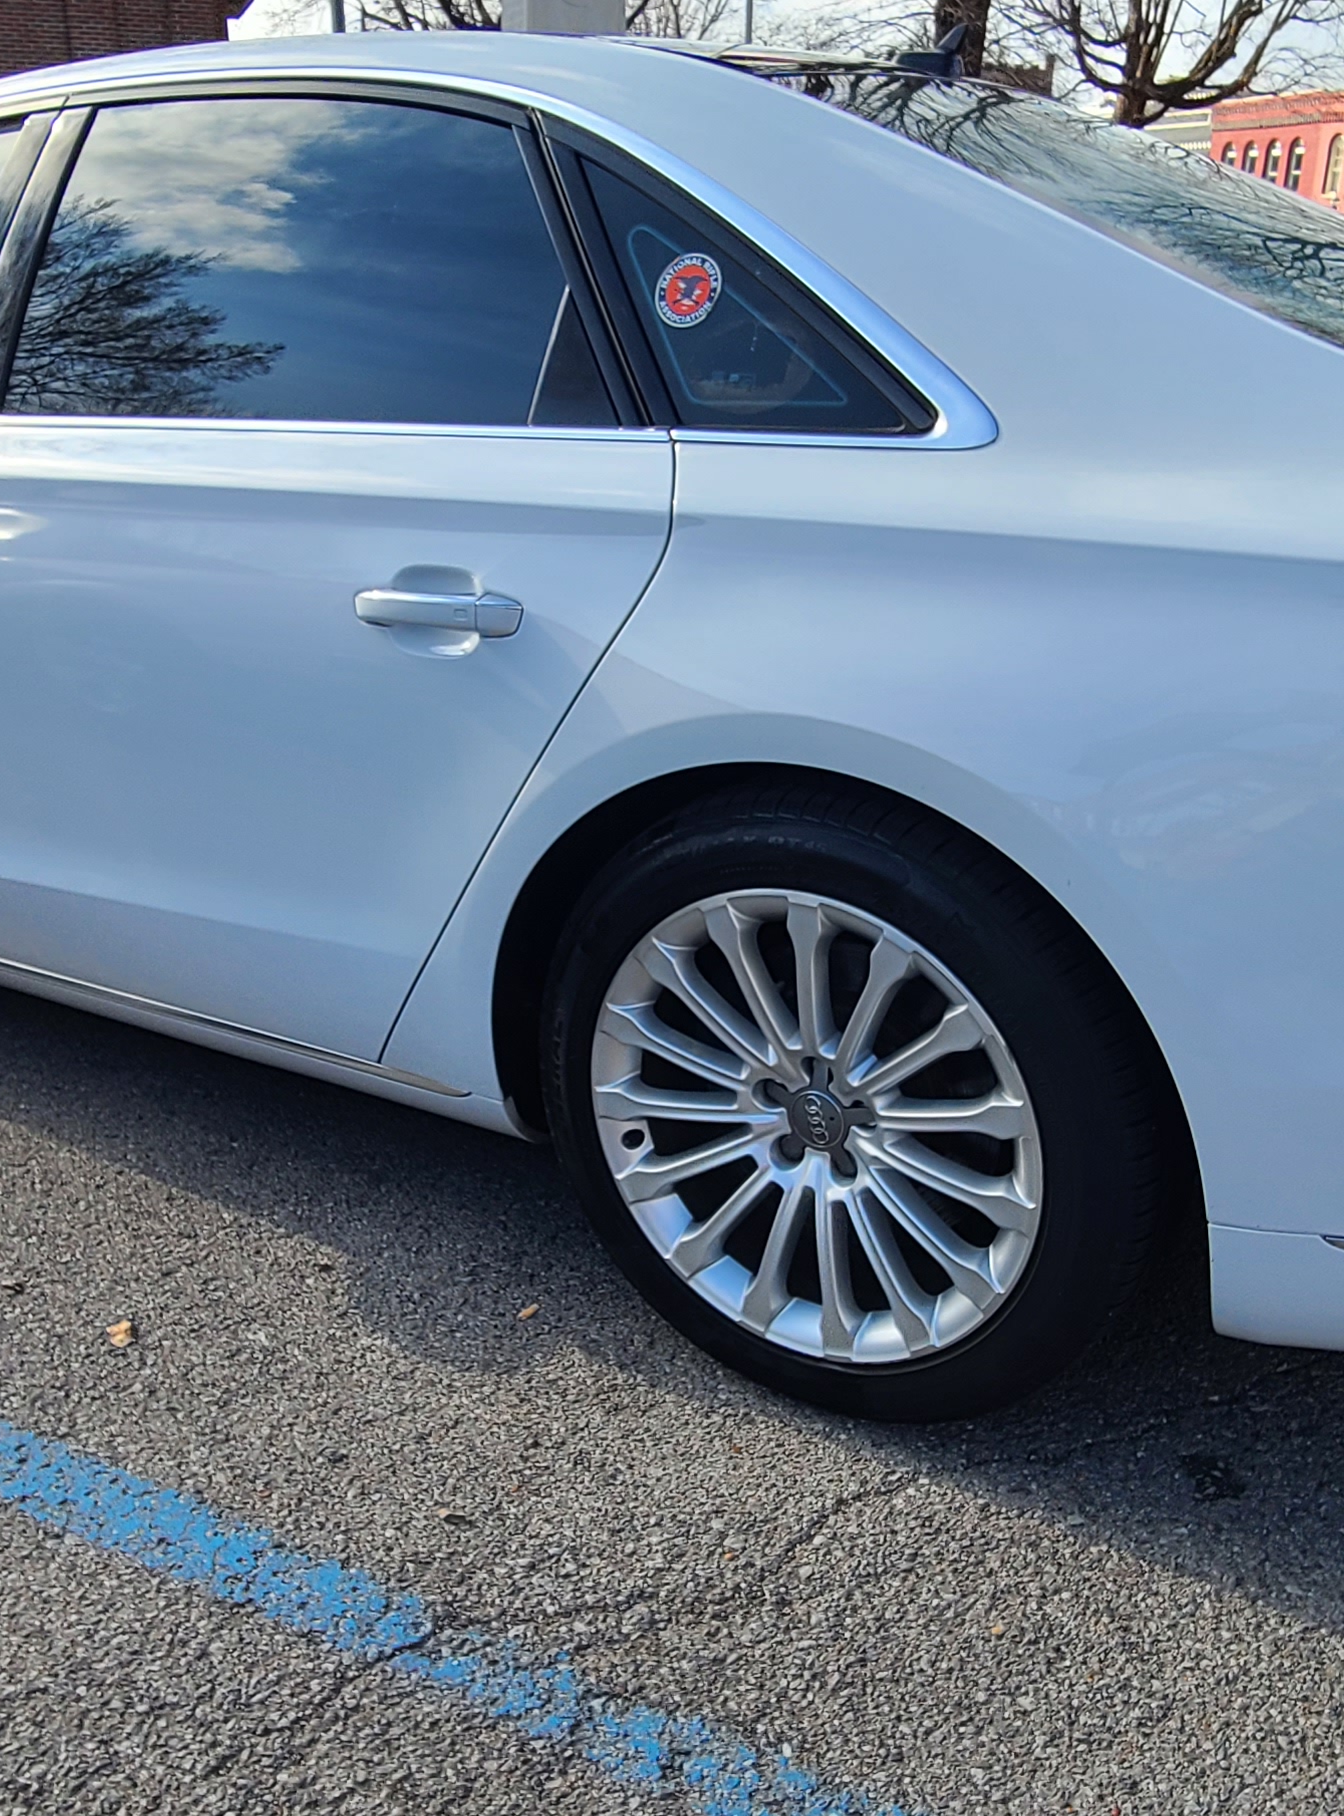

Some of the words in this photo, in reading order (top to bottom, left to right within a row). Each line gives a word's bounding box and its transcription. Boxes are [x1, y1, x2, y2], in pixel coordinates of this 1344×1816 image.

[660, 257, 703, 289] NATIONAL
[702, 261, 718, 289] RIFLE
[659, 300, 712, 323] ASSOCIATION
